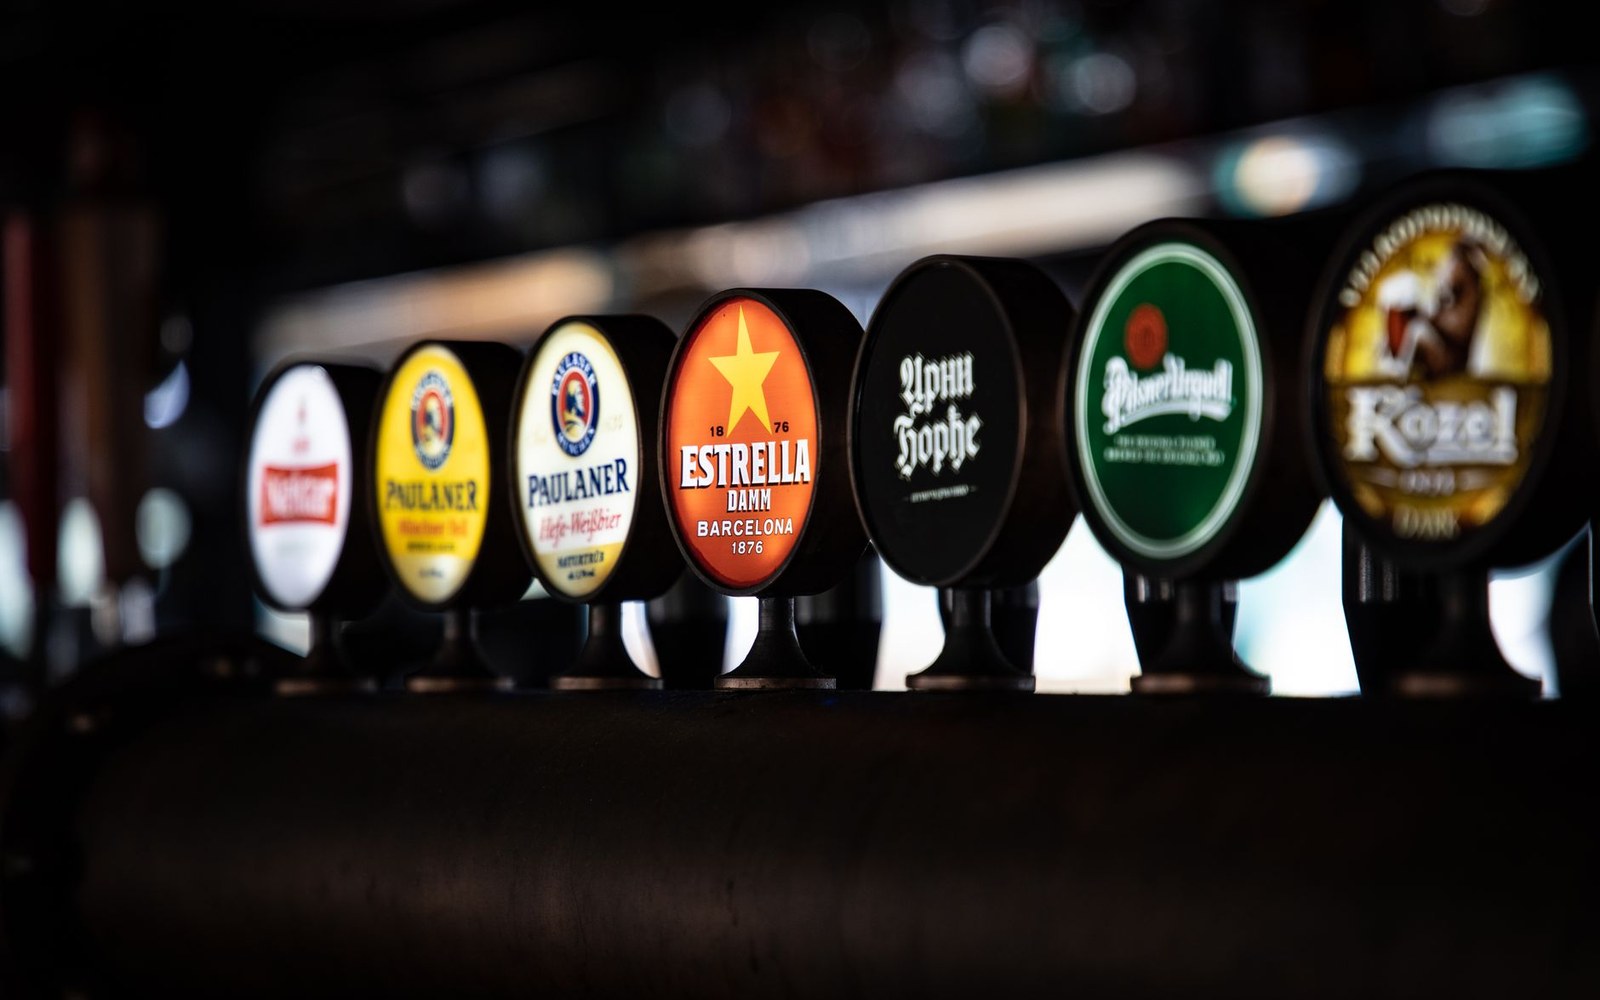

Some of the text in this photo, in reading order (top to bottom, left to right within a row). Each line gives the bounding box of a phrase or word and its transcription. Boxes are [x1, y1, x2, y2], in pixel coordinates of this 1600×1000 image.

[710, 421, 789, 437] 18 76
[1343, 385, 1518, 468] Kozel
[680, 439, 811, 489] ESTRELLA
[385, 480, 478, 511] PAULANER
[528, 458, 630, 507] PAULANER
[727, 489, 771, 512] DAMM
[697, 518, 794, 536] BARCELONA
[731, 541, 764, 554] 1876
